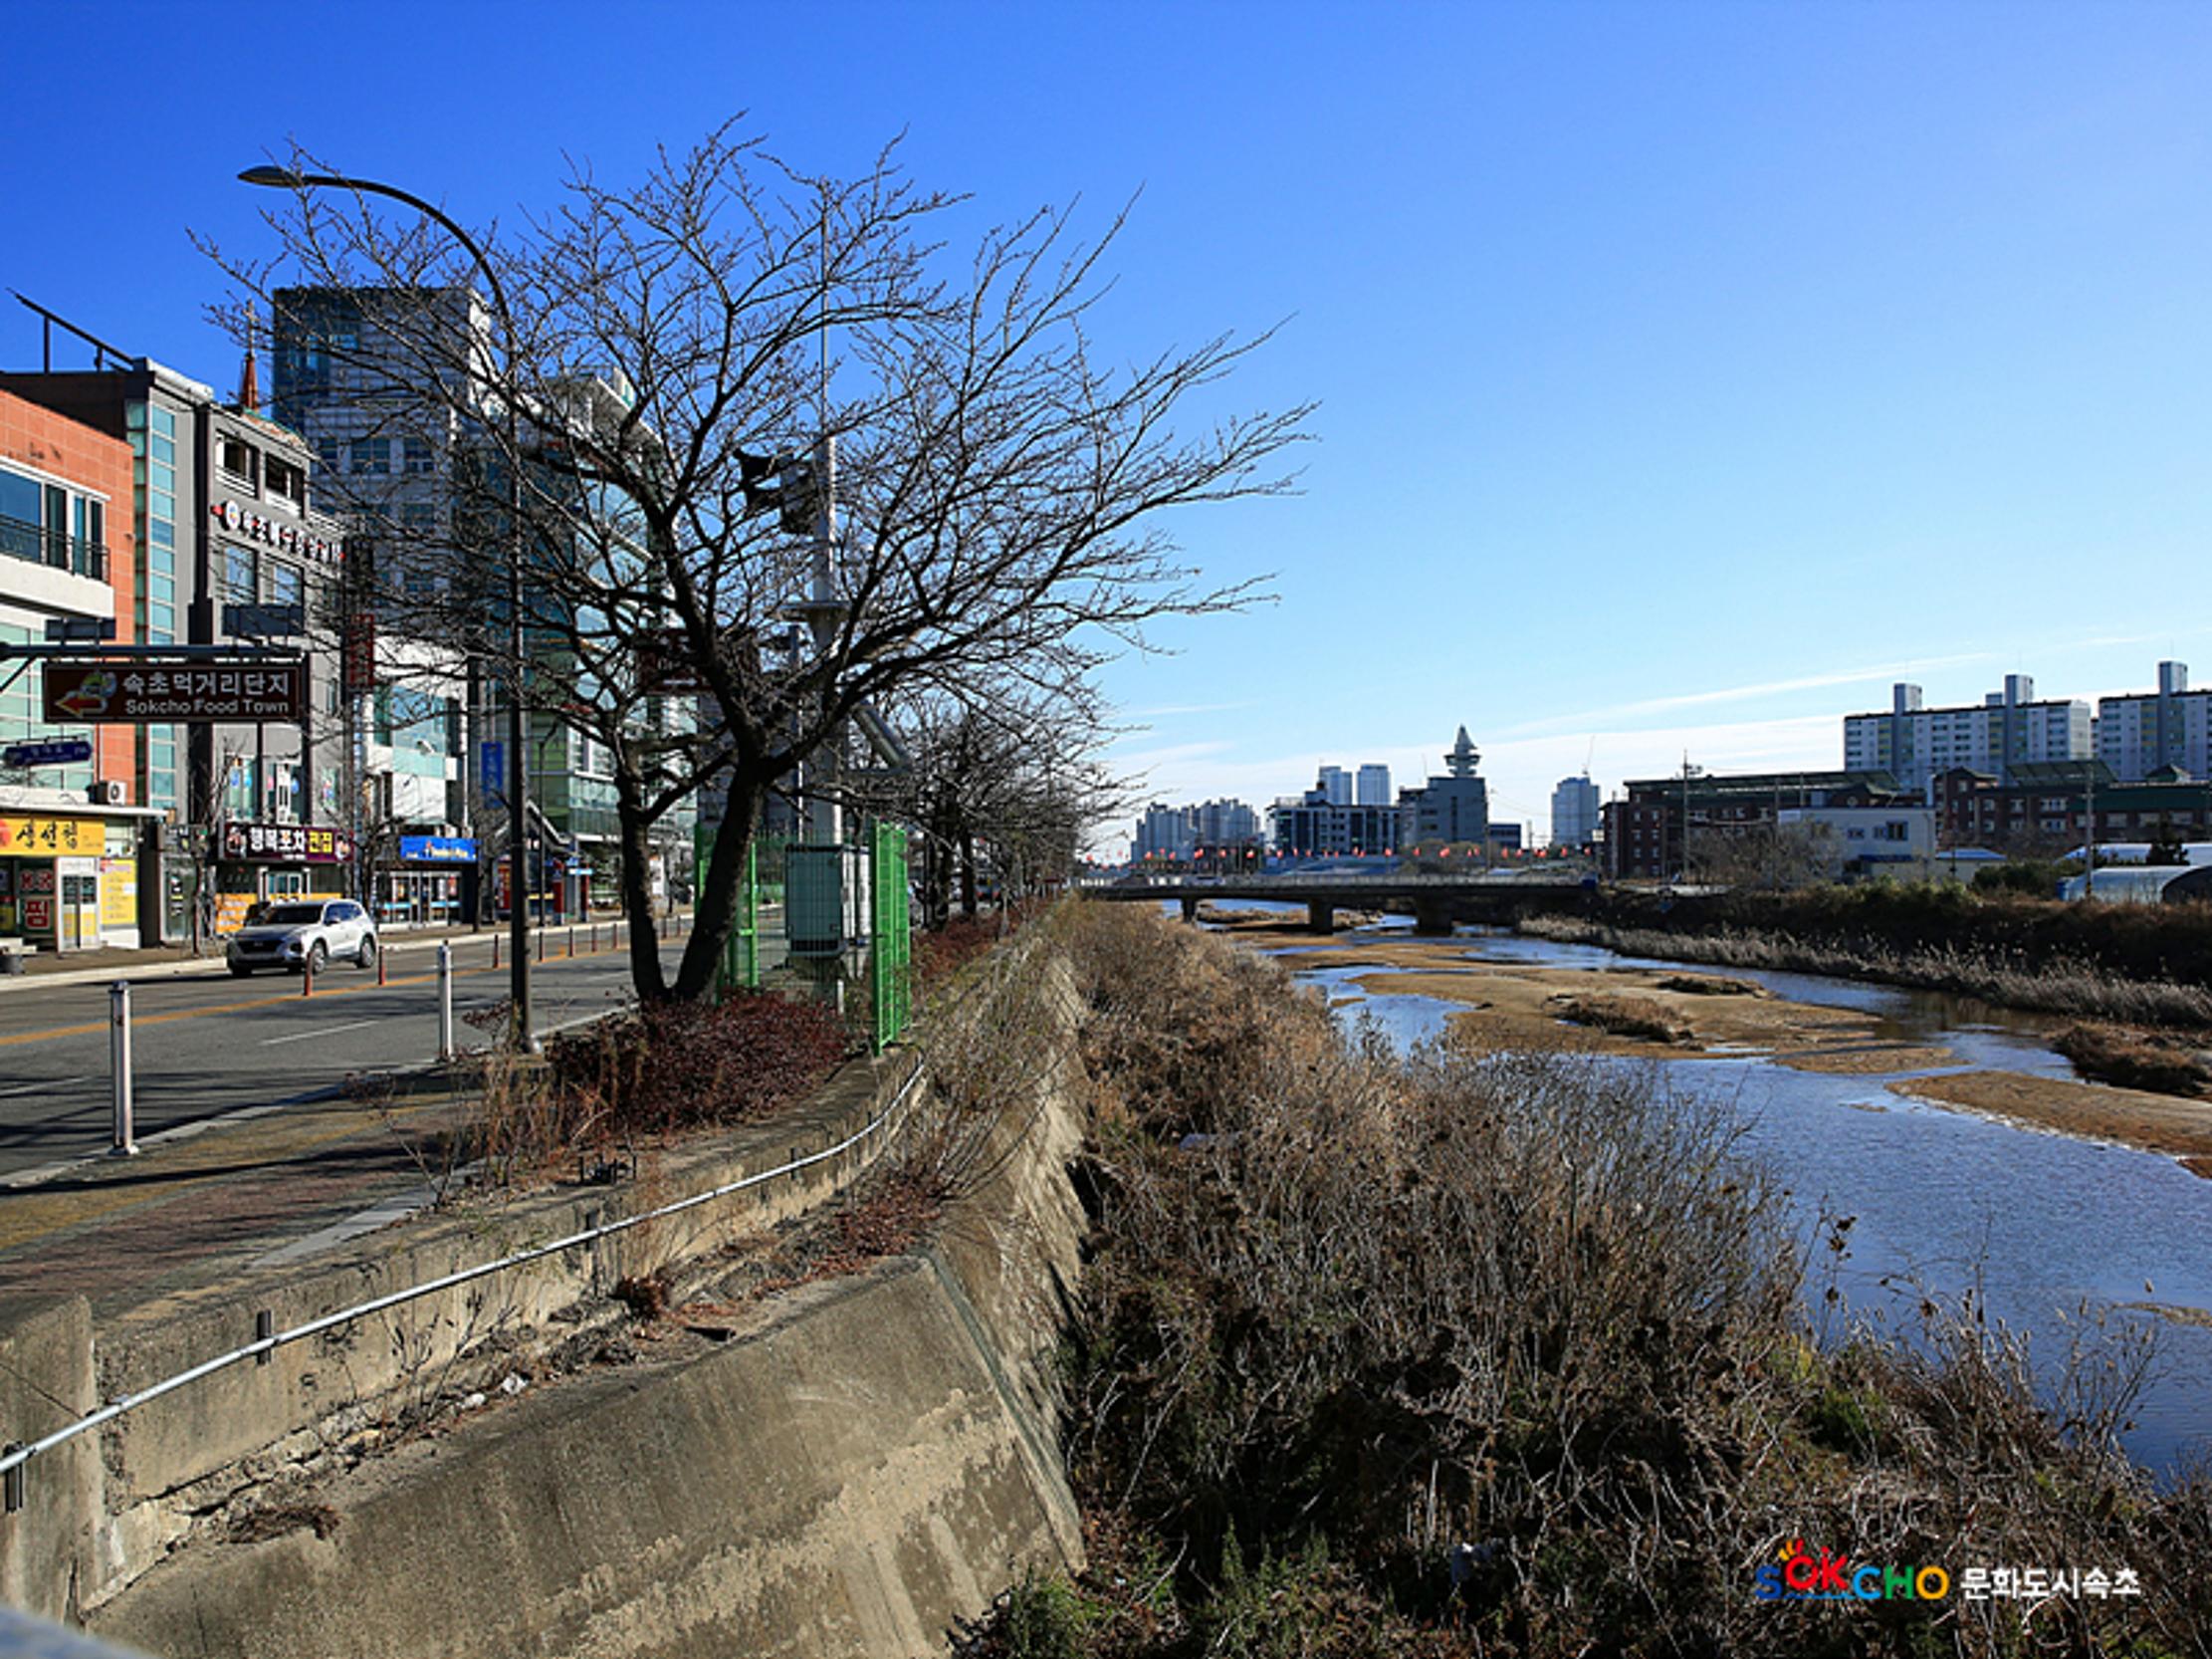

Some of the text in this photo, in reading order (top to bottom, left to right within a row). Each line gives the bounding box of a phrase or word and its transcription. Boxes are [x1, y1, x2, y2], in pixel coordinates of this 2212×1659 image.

[123, 671, 289, 695] 속초먹거리단지
[125, 699, 289, 714] Sokcho Food Town
